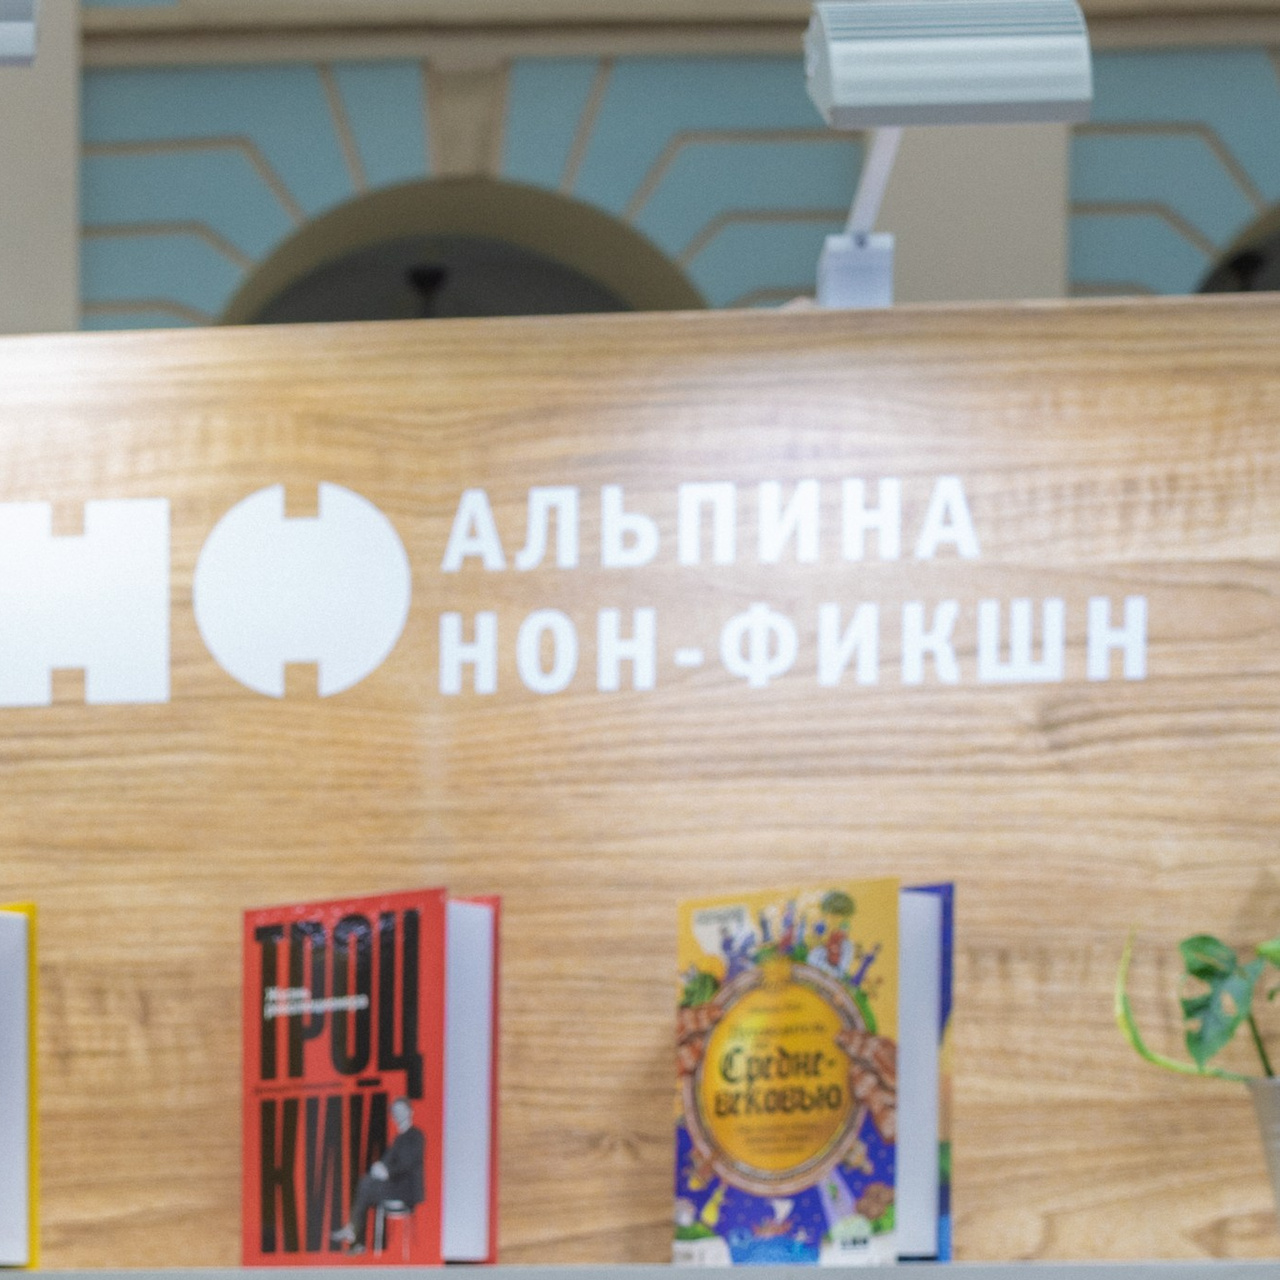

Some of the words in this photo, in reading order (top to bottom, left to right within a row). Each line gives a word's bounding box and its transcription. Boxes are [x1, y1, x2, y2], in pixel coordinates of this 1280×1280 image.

[440, 475, 982, 573] АЛЬПИНА
[438, 594, 1149, 696] НОН-ФИКШН
[254, 908, 423, 1099] ТРОЦ
